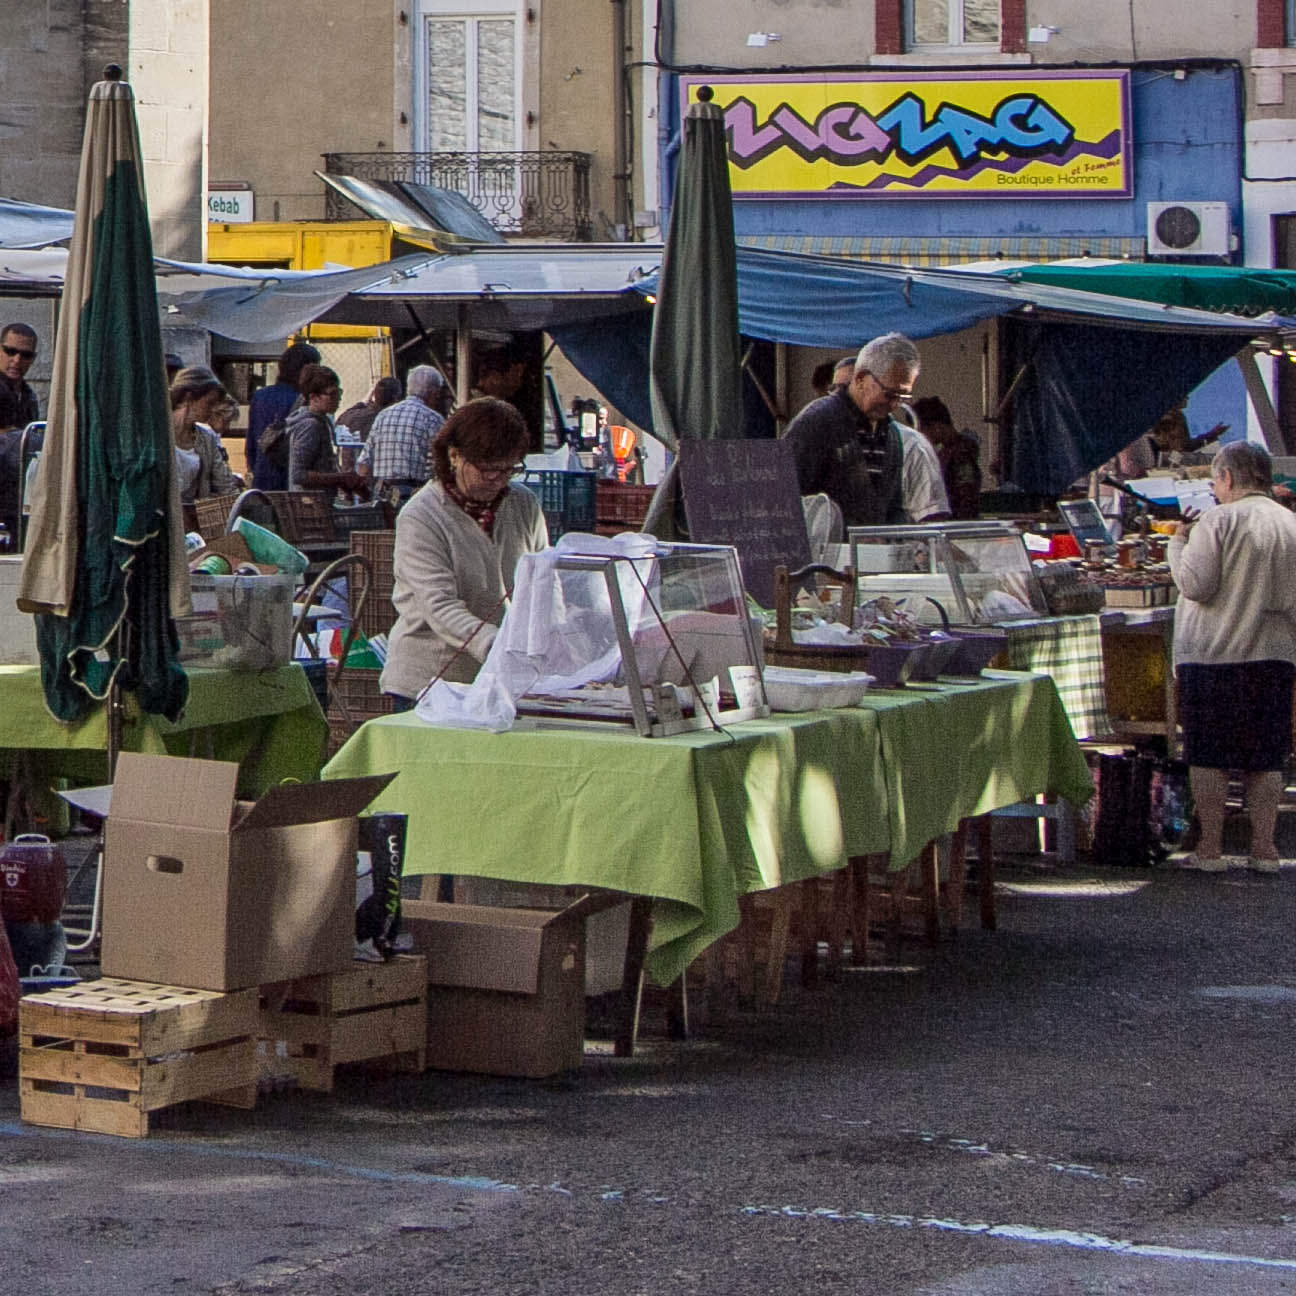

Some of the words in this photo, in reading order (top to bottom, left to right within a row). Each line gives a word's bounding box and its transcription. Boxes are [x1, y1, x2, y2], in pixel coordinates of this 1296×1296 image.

[1084, 159, 1121, 172] Femme
[996, 173, 1054, 187] Boutique
[1057, 174, 1109, 185] Homme
